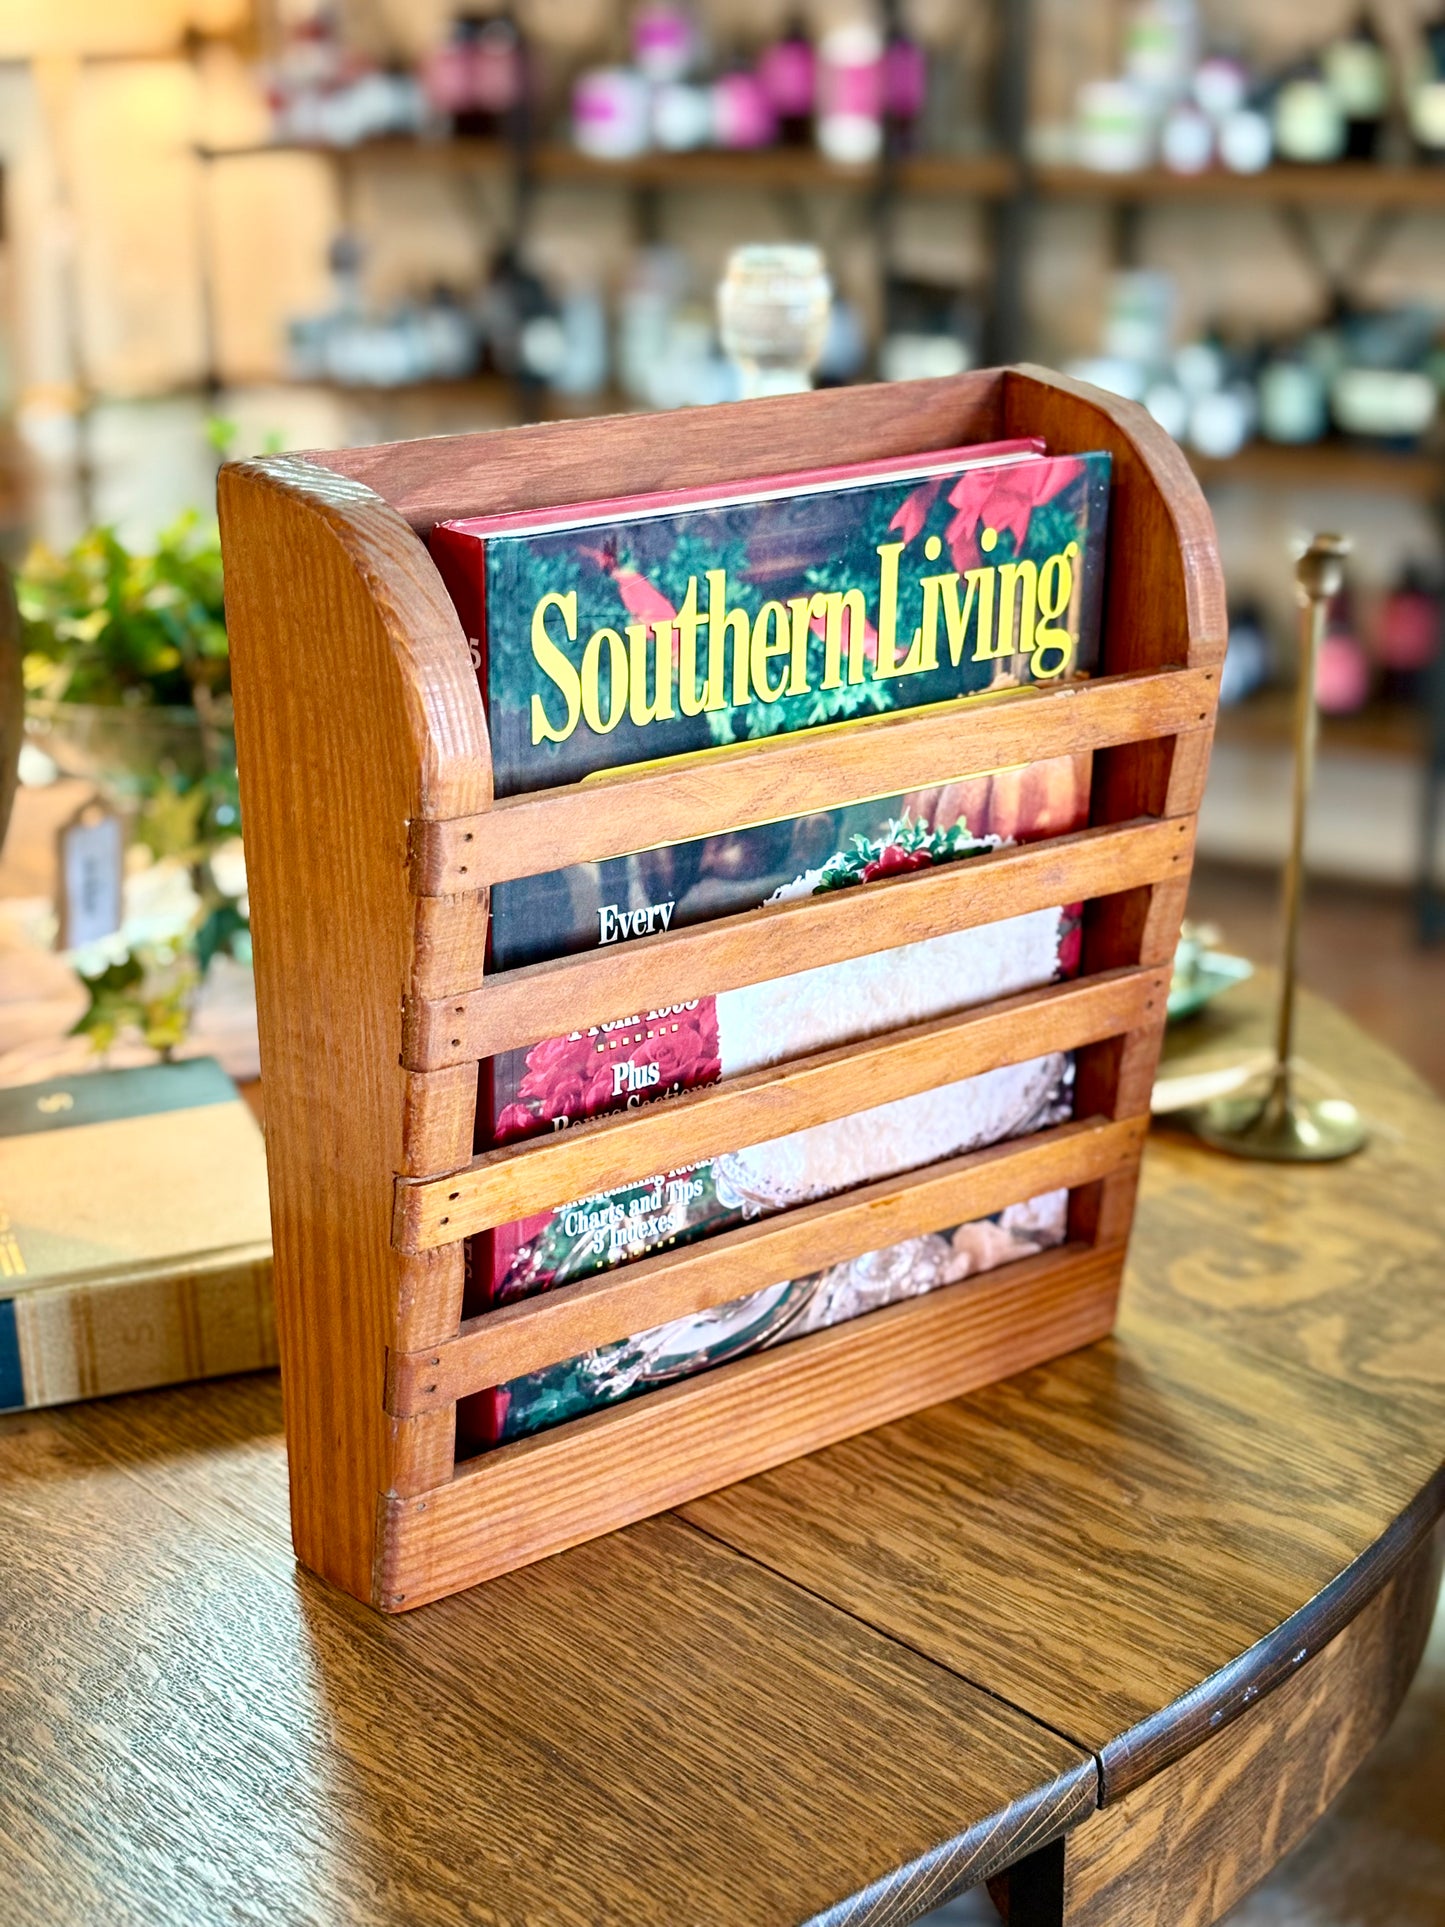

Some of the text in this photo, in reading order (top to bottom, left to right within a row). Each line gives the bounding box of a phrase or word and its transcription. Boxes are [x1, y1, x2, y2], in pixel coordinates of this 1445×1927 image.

[532, 528, 1077, 745] Southern Living
[598, 901, 675, 944] Every
[611, 1060, 661, 1096] Plus
[564, 1203, 624, 1237] Charts
[629, 1188, 662, 1216] and
[666, 1179, 704, 1206] Tips
[609, 1213, 678, 1249] Indexes
